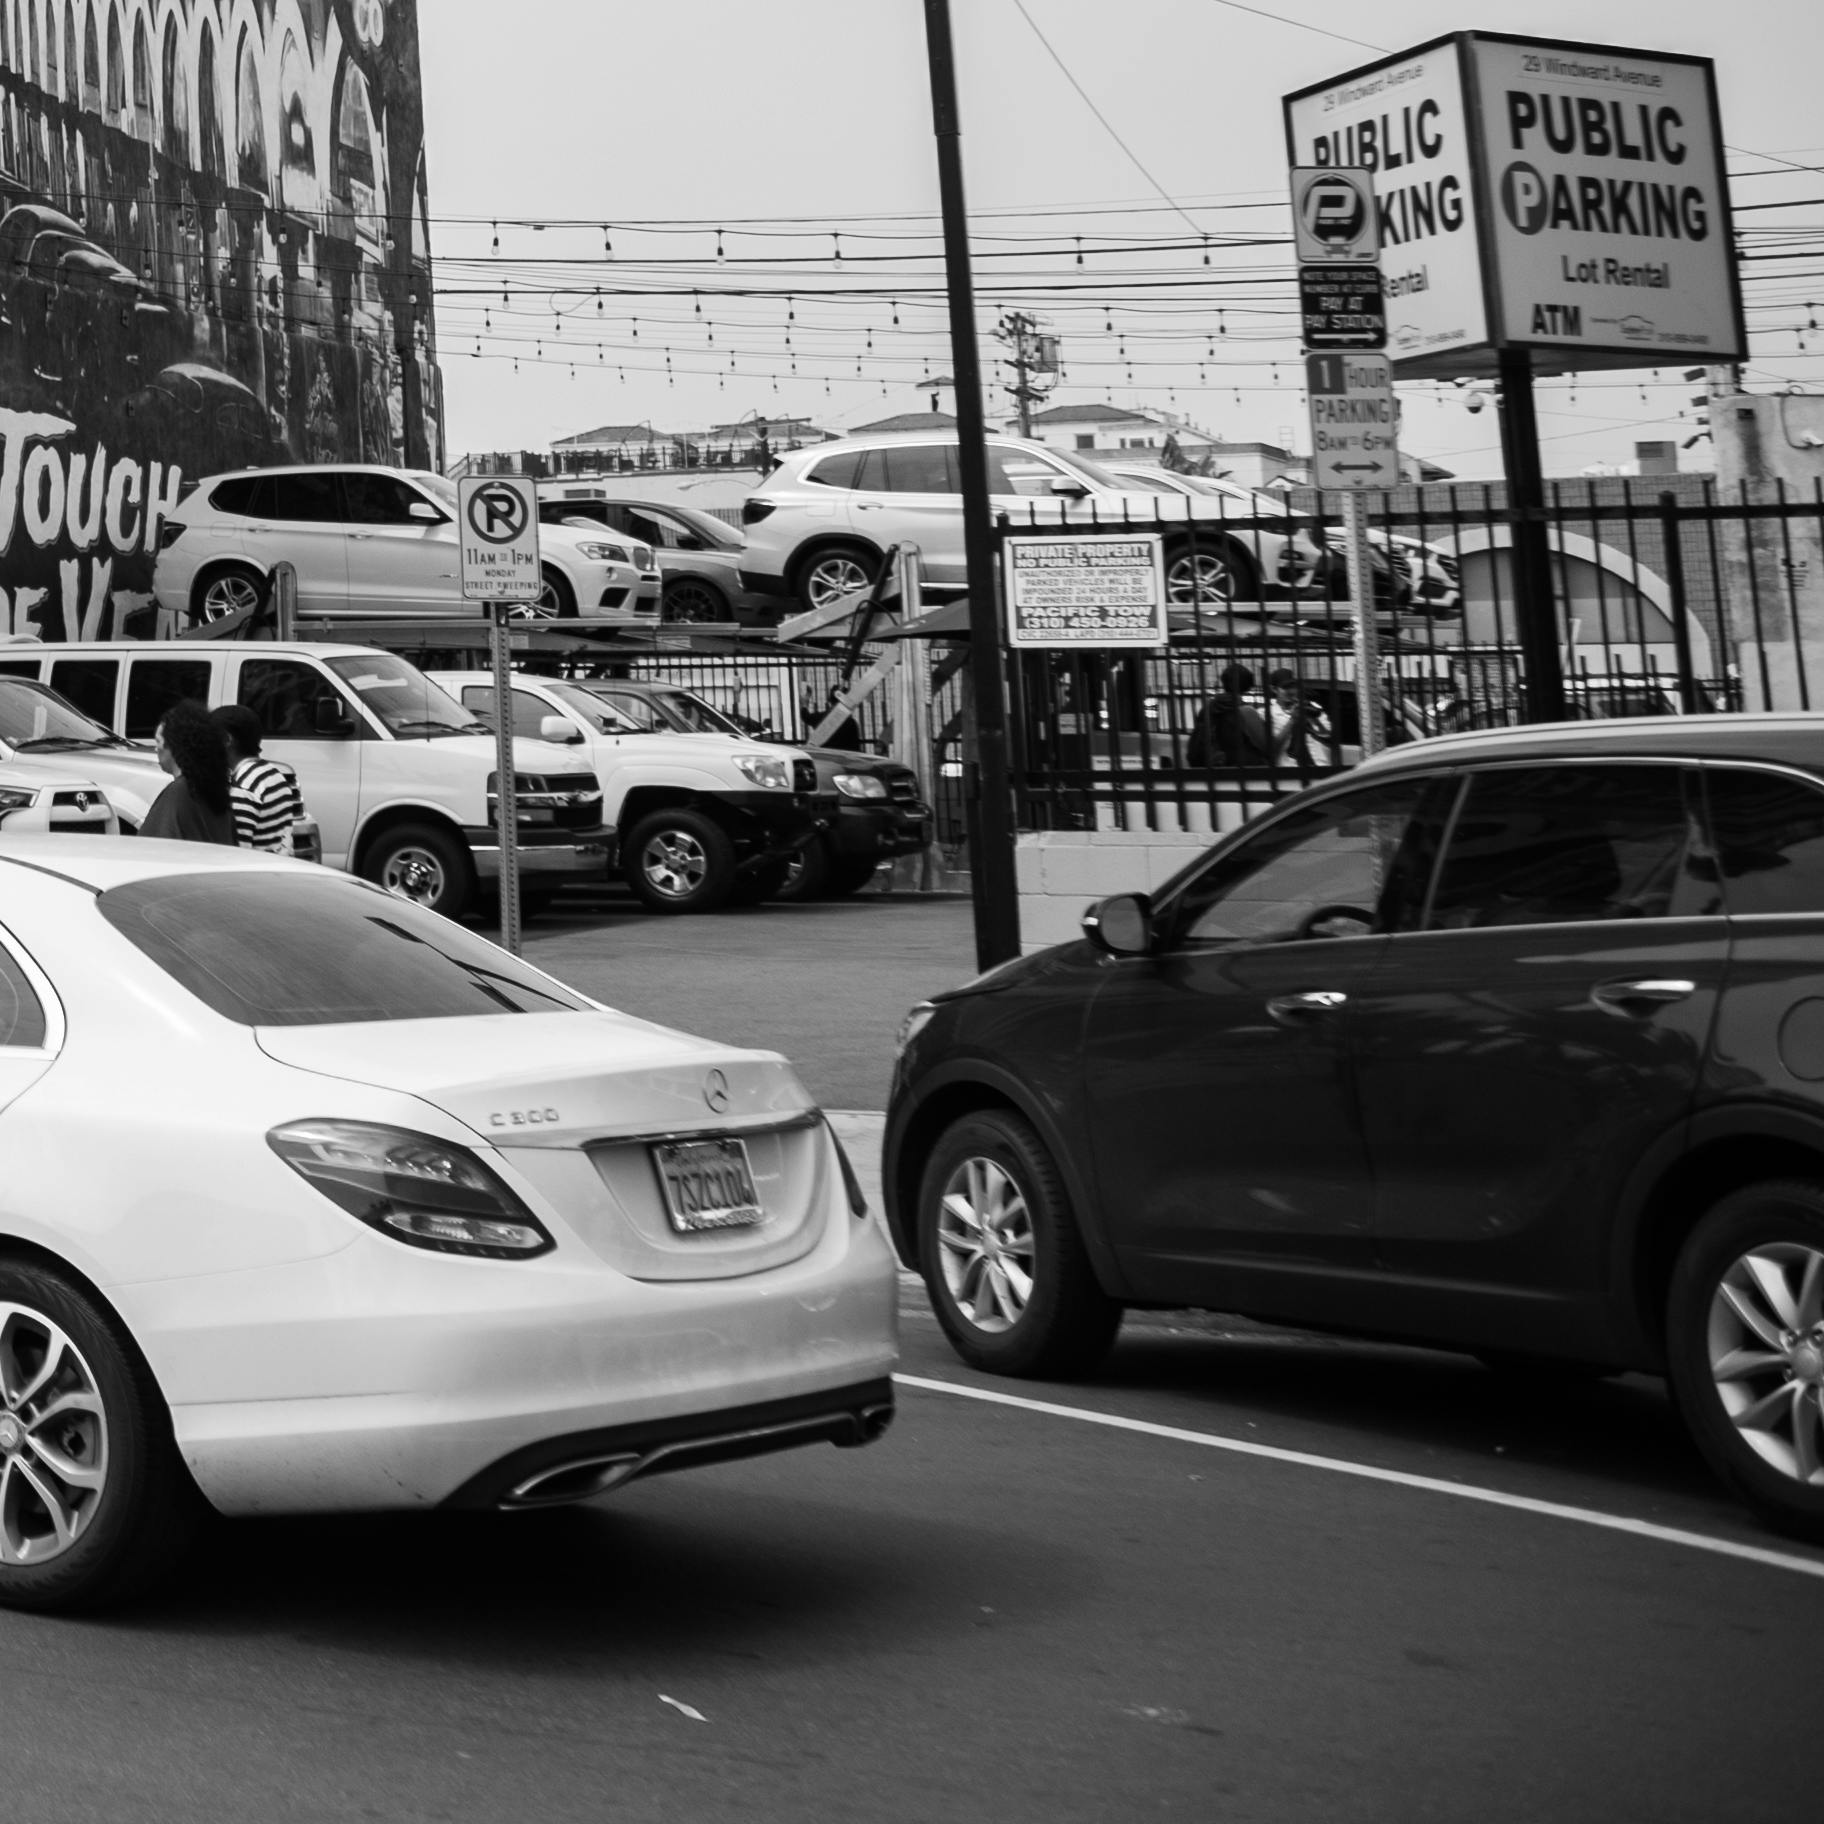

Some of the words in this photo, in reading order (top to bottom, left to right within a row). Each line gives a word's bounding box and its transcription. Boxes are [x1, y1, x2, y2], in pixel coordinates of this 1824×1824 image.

[1506, 90, 1688, 166] PUBLIC
[1373, 175, 1464, 248] KING
[1507, 164, 1709, 242] PARKING
[1561, 255, 1600, 284] Lot
[1603, 257, 1671, 289] Rental
[1319, 297, 1344, 311] PAY
[1348, 297, 1363, 311] AT
[1304, 315, 1327, 329] PAY
[1331, 315, 1383, 329] STATION
[1531, 303, 1582, 337] ATM
[1320, 360, 1331, 389] 1
[1349, 368, 1389, 388] HOUR
[1315, 398, 1392, 423] PARKING
[467, 547, 496, 565] 11AM
[511, 548, 534, 565] 1PM
[1015, 545, 1075, 558] PRIVATE
[1077, 544, 1150, 558] PROPERTY
[1015, 558, 1037, 568] NO
[1039, 557, 1088, 567] PUBLIC
[1090, 556, 1151, 567] PARKING
[484, 569, 516, 577] MONDAY
[465, 581, 494, 590] STREET
[497, 581, 539, 590] SWEEPING
[1020, 607, 1102, 617] PACIFIC
[1103, 606, 1153, 616] TOW
[1025, 617, 1065, 629] (310)
[490, 1112, 505, 1126] C
[511, 1108, 560, 1125] 300
